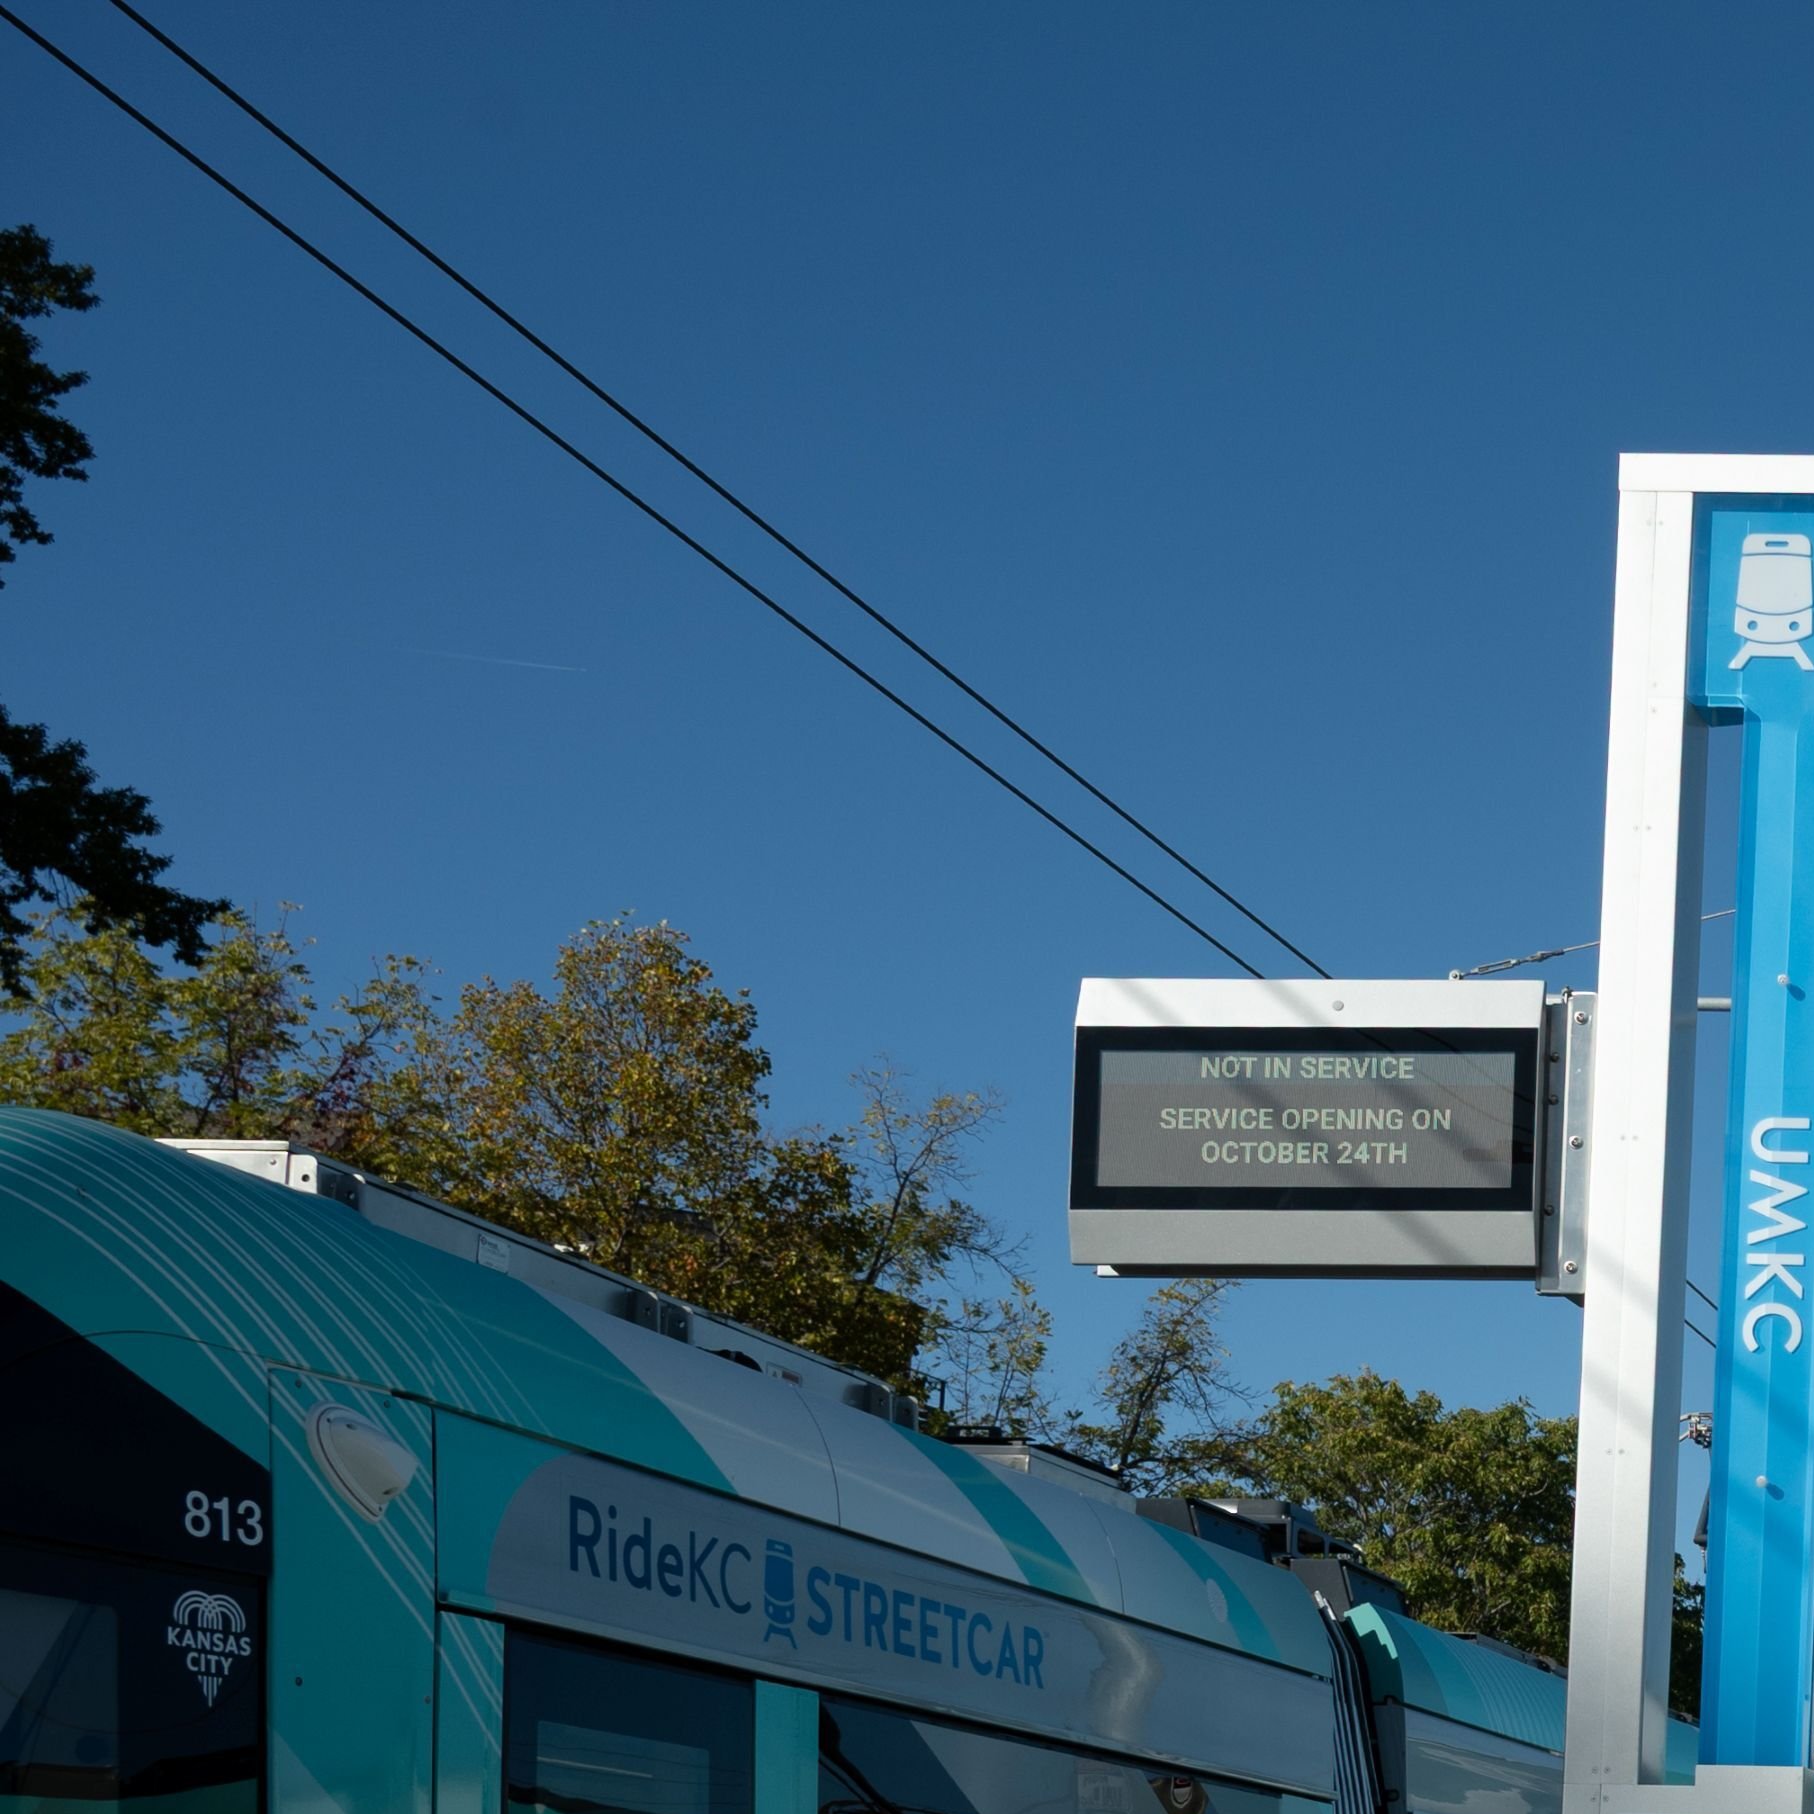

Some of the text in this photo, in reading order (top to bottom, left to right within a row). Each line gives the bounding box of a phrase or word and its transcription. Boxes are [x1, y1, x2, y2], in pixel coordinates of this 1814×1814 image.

[1201, 1057, 1414, 1079] NOT IN SERVICE
[1160, 1108, 1451, 1130] SERVICE OPENING ON
[1201, 1142, 1407, 1164] OCTOBER 24TH
[1742, 1117, 1811, 1353] UMKC
[184, 1489, 264, 1547] 813
[568, 1494, 1044, 1690] RideKC STREETCAR
[166, 1626, 252, 1657] KANSAS
[186, 1652, 233, 1676] CITY
